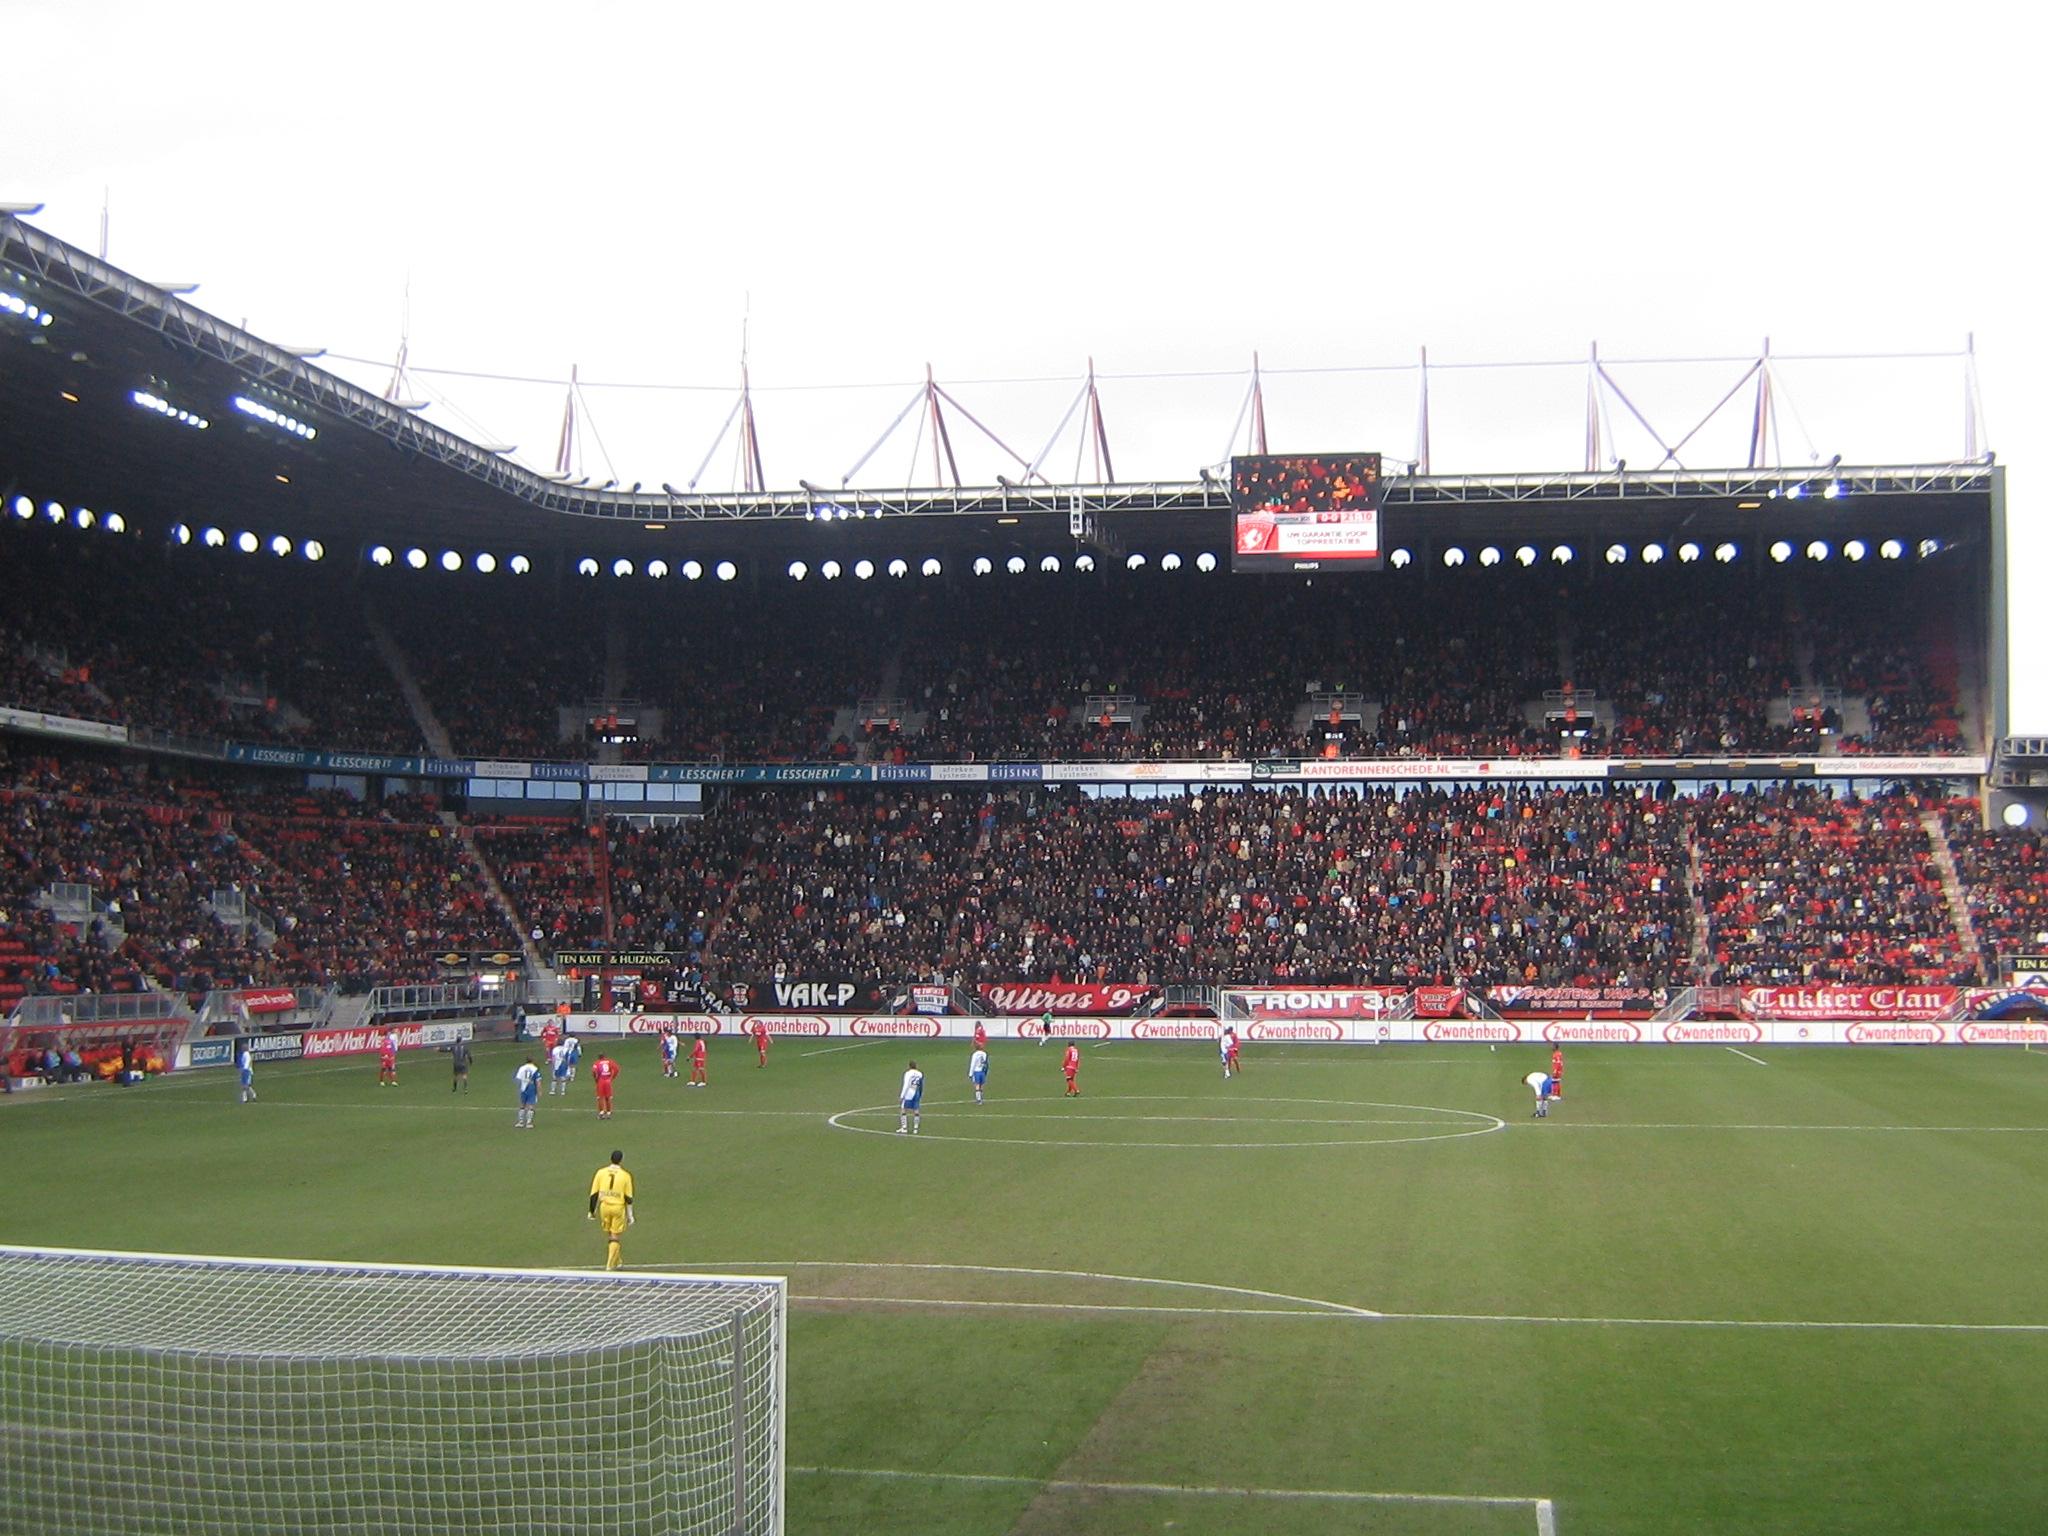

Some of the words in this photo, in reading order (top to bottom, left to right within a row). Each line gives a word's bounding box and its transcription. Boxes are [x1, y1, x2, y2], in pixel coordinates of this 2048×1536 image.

[328, 756, 384, 769] LESSCHER
[1303, 764, 1451, 775] KANTORENINENSCHEDE.NL
[679, 769, 734, 780] LESSCHER
[775, 769, 829, 780] LESSCHER
[558, 955, 577, 964] TEN
[579, 955, 602, 964] KATE
[609, 955, 619, 964] &
[619, 954, 671, 965] HUIZINGA
[2015, 959, 2037, 969] TEN
[774, 983, 856, 1009] VAK-P
[988, 986, 1094, 1010] Ultras
[1244, 993, 1357, 1012] FRONT
[1750, 987, 1864, 1009] Tukker
[1869, 988, 1943, 1010] Clan
[859, 1019, 931, 1036] Zwanenberg
[1141, 1022, 1216, 1038] Zwanenberg
[1257, 1023, 1332, 1040] Zwanenberg
[1433, 1024, 1510, 1041] Zwanenberg
[1552, 1025, 1630, 1042] Zwanenberg
[1673, 1024, 1750, 1041] Zwanenberg
[1856, 1025, 1934, 1042] Zwanenberg
[248, 1034, 303, 1051] LAMMERINK
[303, 1034, 334, 1054] Media
[608, 1173, 616, 1190] 1
